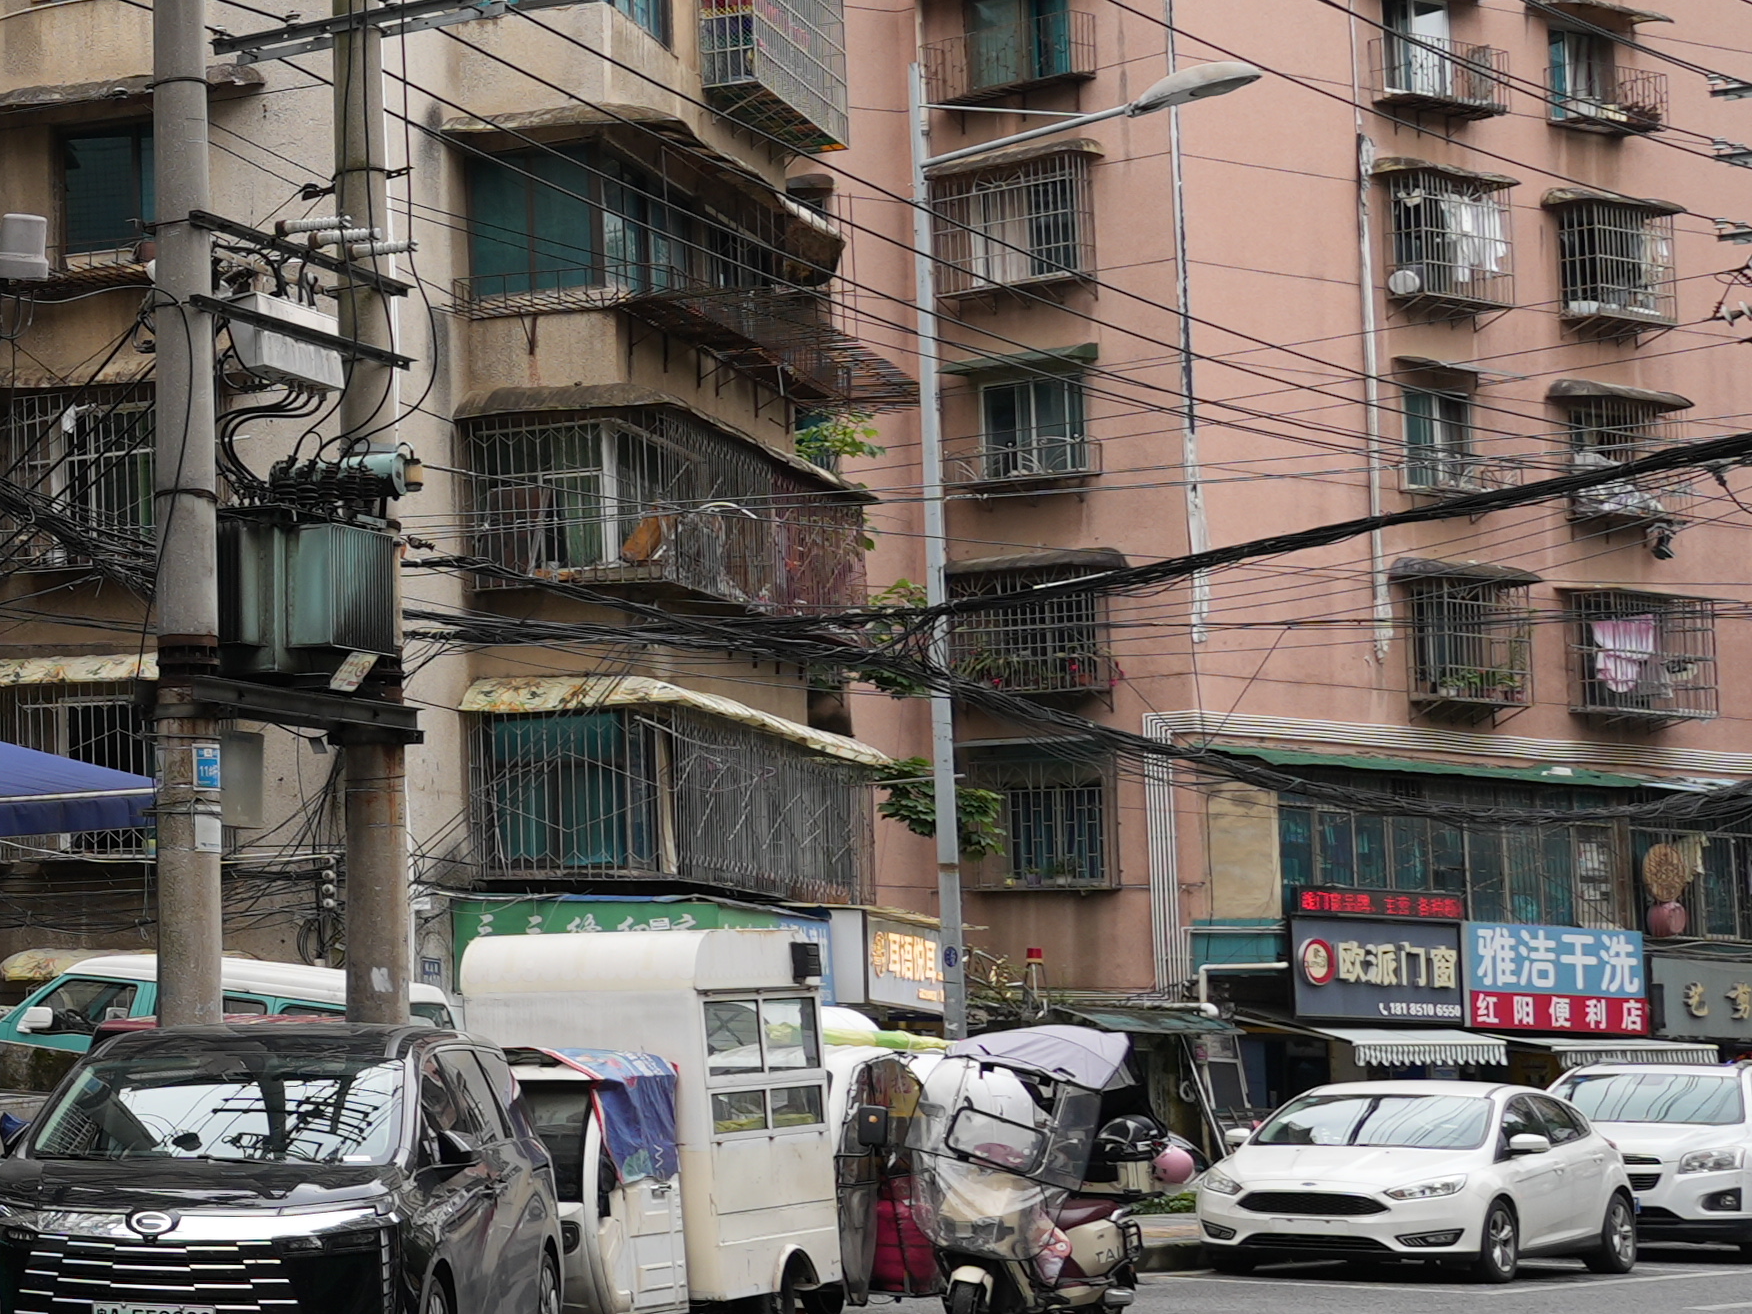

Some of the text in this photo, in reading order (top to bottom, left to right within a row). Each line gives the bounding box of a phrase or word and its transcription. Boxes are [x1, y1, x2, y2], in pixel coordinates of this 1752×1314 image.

[1338, 942, 1458, 989] 欧派门窗
[1477, 927, 1640, 994] 雅洁干洗
[1476, 993, 1643, 1031] 红阳便利店
